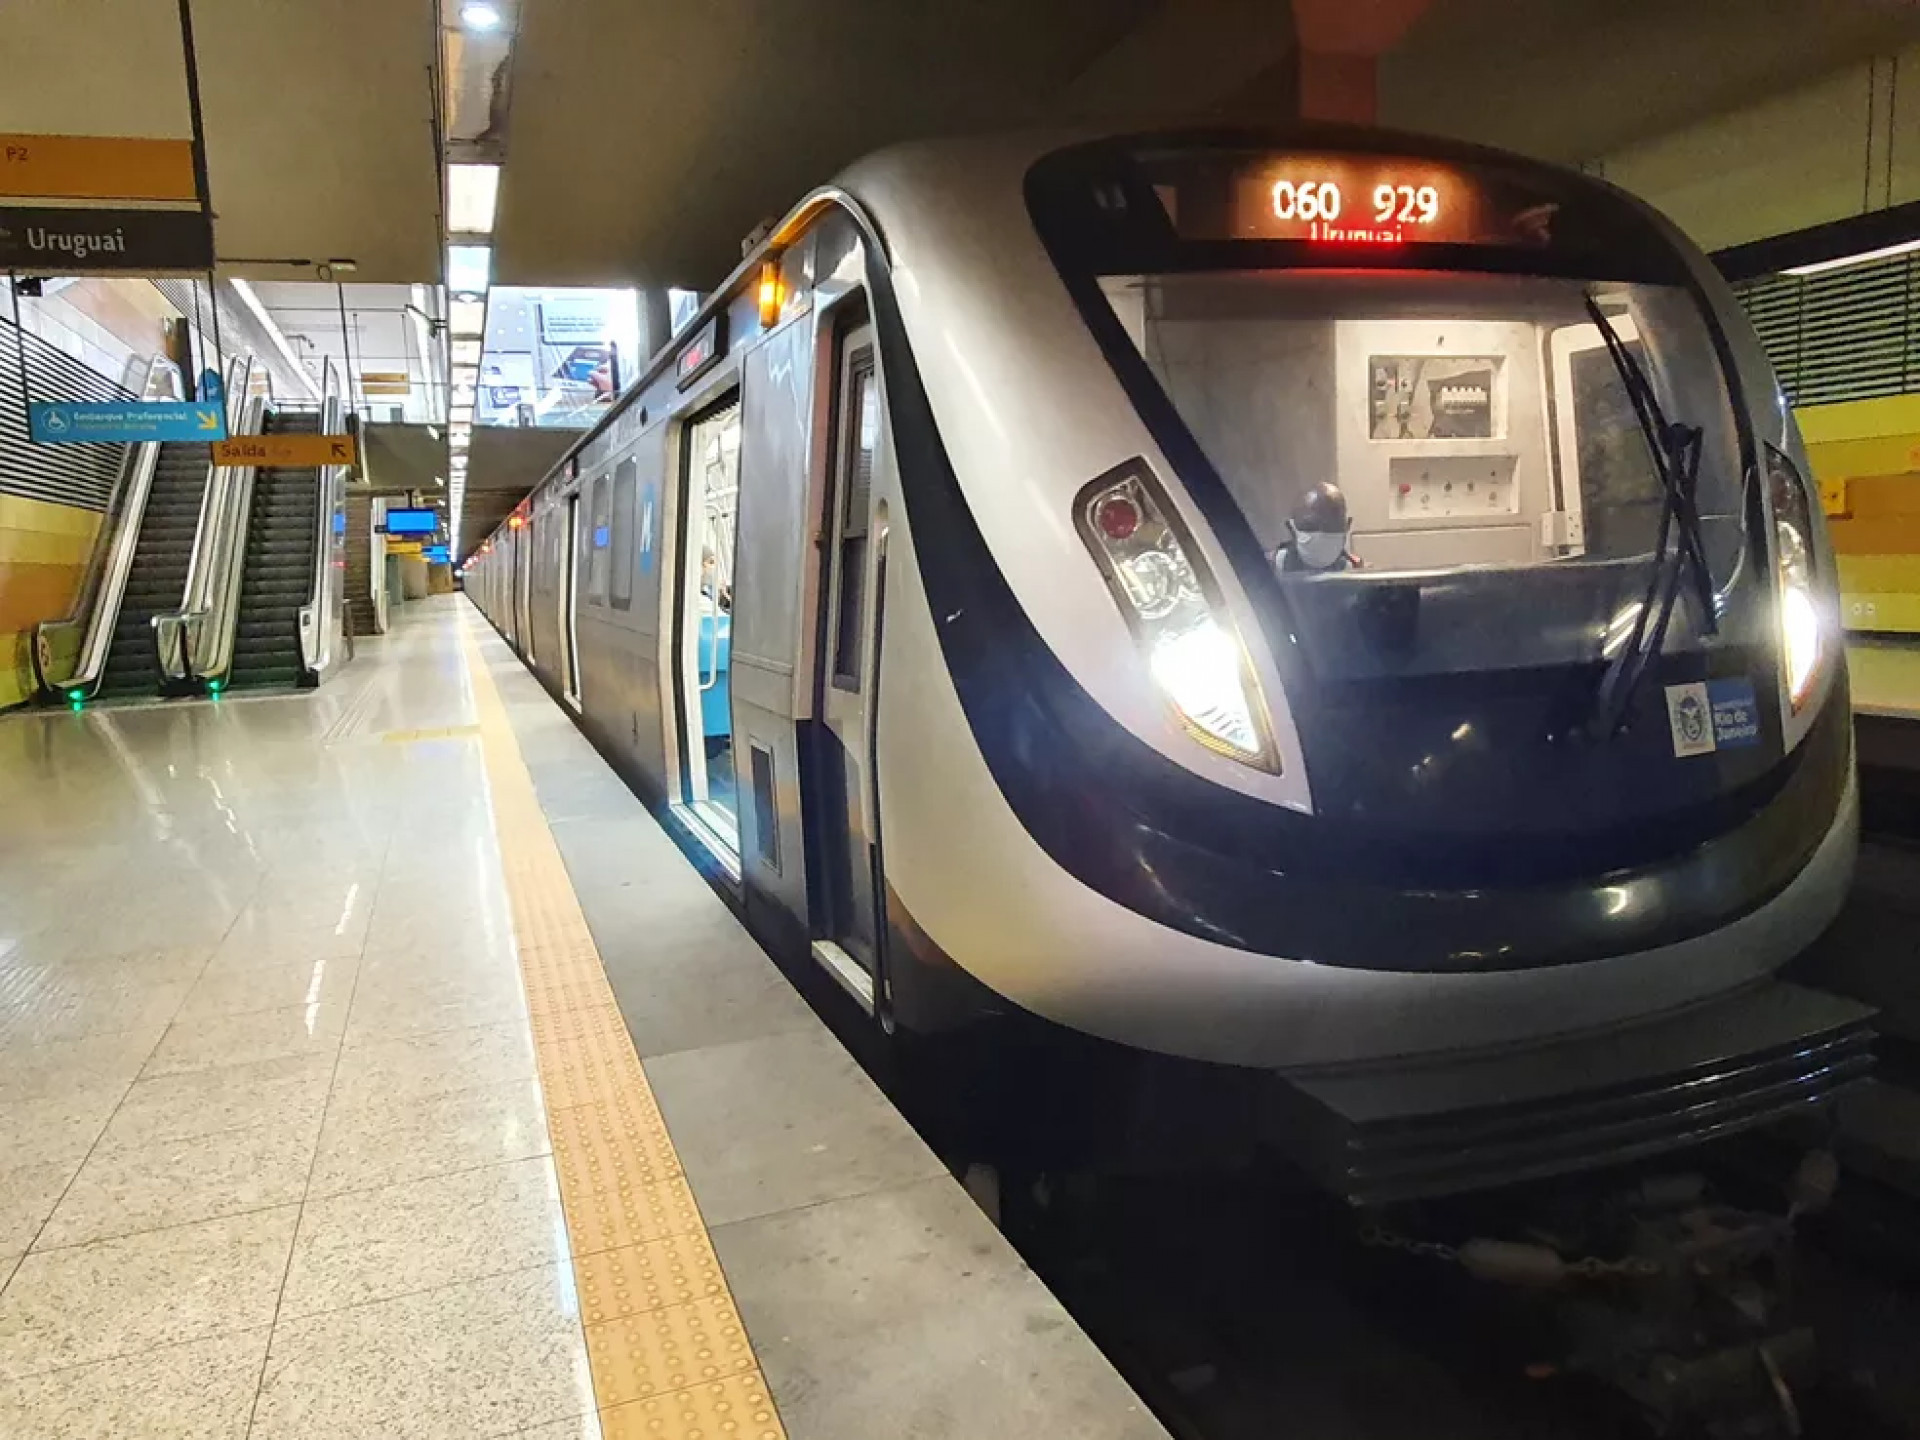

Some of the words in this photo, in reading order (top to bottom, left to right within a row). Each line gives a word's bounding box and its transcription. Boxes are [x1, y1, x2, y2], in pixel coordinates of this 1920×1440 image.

[6, 145, 28, 161] P2
[1273, 181, 1341, 221] 060
[1373, 184, 1439, 223] 929
[26, 227, 125, 258] Uruguai
